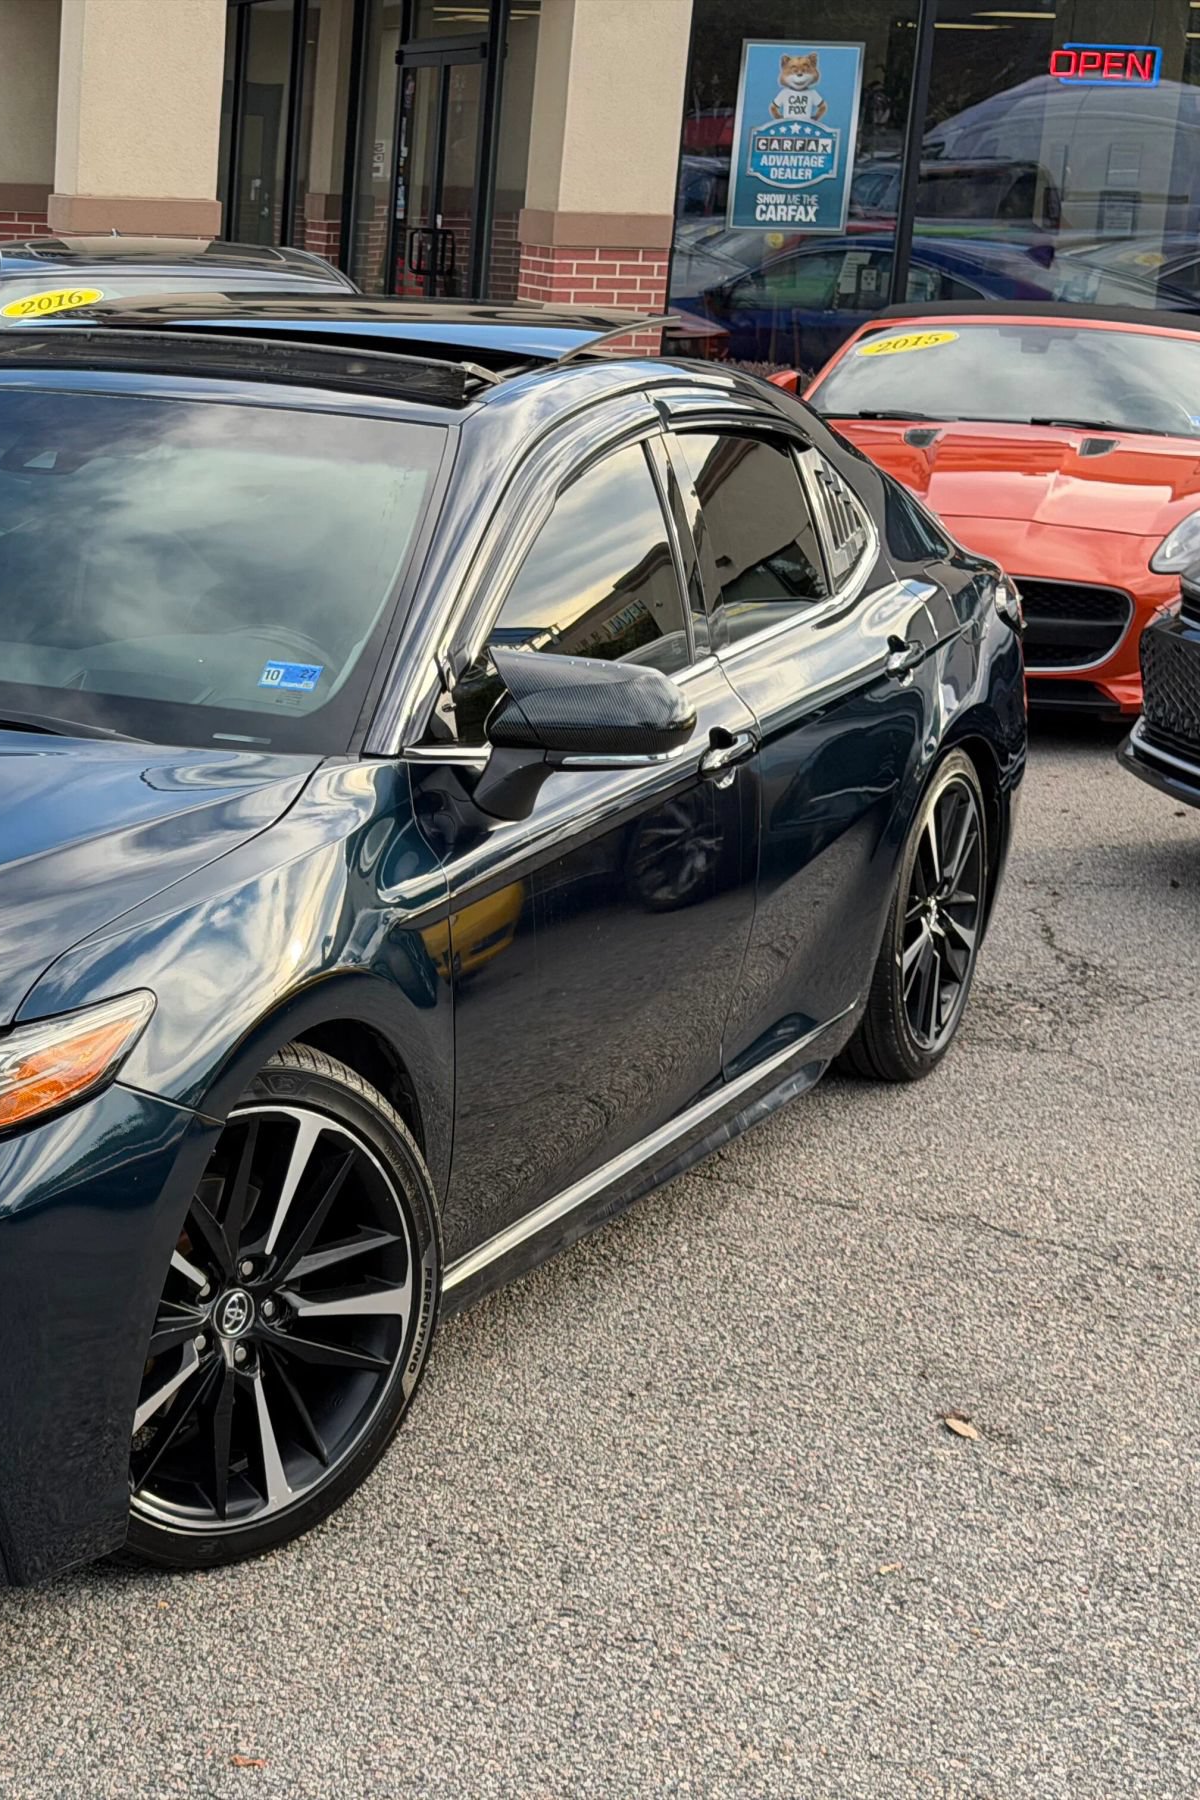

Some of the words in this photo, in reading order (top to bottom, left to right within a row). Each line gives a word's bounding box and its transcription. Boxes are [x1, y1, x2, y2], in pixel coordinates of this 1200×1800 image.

[1049, 50, 1153, 80] OPEN
[788, 95, 808, 105] CAR
[788, 105, 807, 115] FOX
[757, 138, 831, 153] CARFAX
[760, 154, 825, 168] ADVANTAGE
[770, 167, 812, 180] DEALER
[756, 193, 786, 205] SHOW
[787, 194, 801, 206] ME
[802, 194, 819, 206] THE
[755, 205, 817, 222] CARFAX
[20, 290, 83, 315] 2016
[875, 333, 943, 353] 2015
[265, 669, 280, 681] 10
[407, 1267, 432, 1374] FERENTINO
